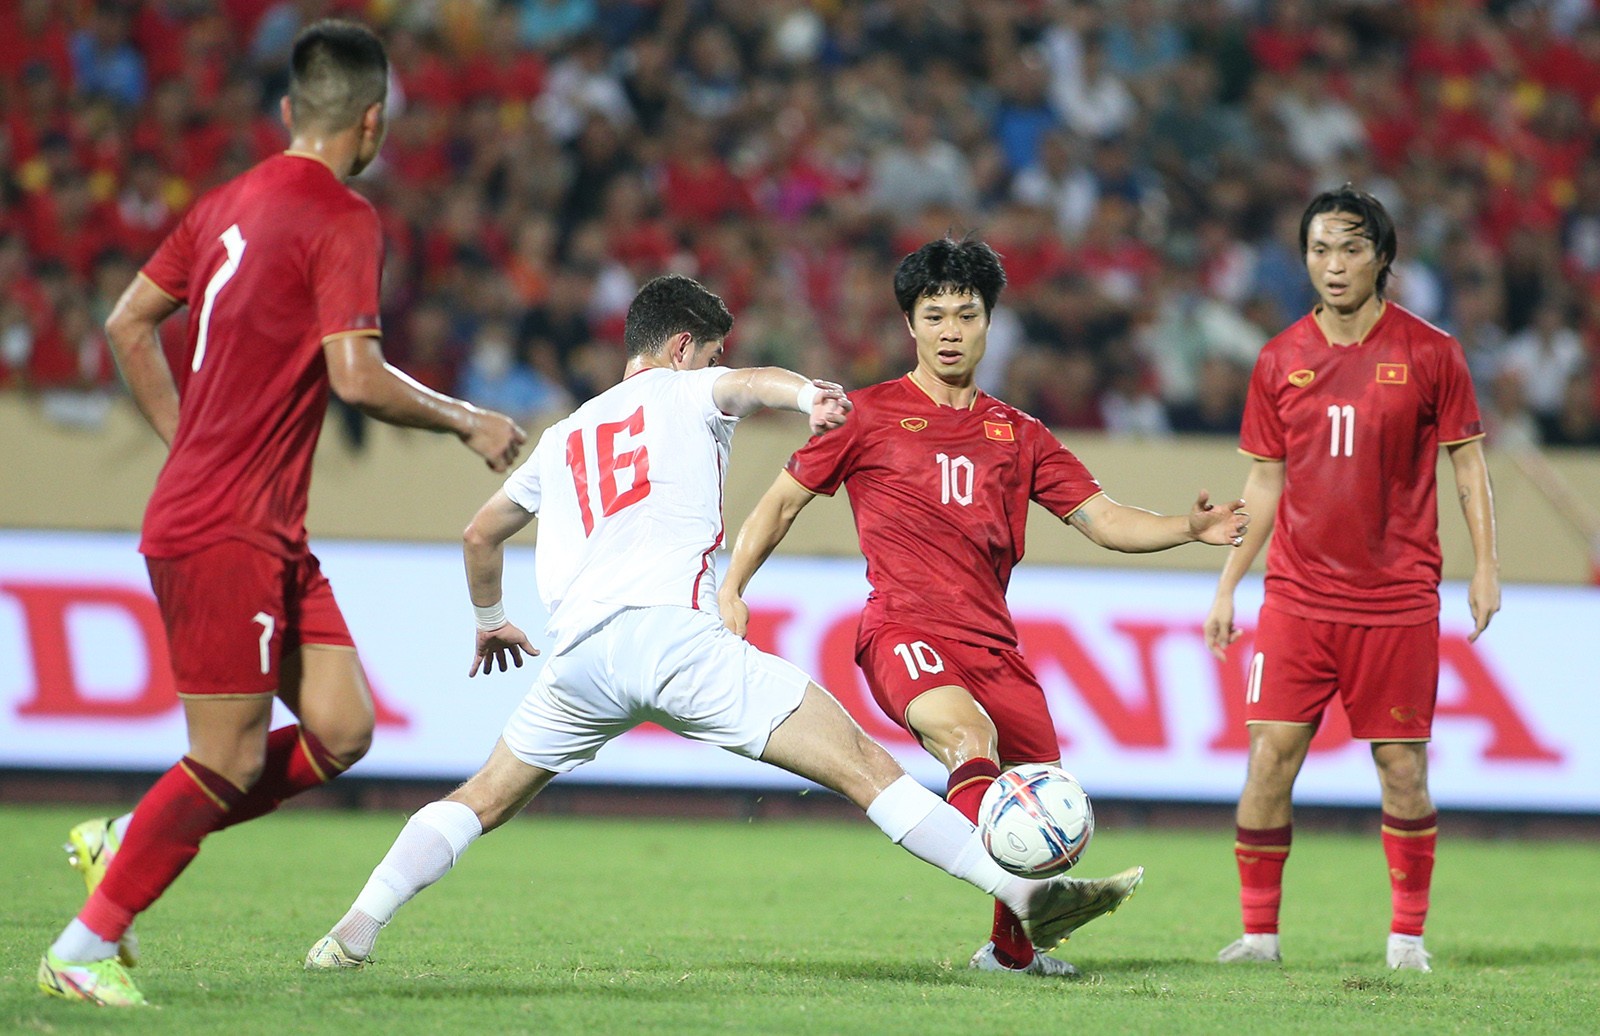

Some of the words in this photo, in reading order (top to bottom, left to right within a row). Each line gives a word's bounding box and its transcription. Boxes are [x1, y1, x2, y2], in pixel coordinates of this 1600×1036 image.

[1326, 404, 1355, 458] 11
[565, 404, 652, 540] 16
[935, 452, 975, 507] 10
[250, 611, 275, 676] 7
[893, 640, 945, 681] 10
